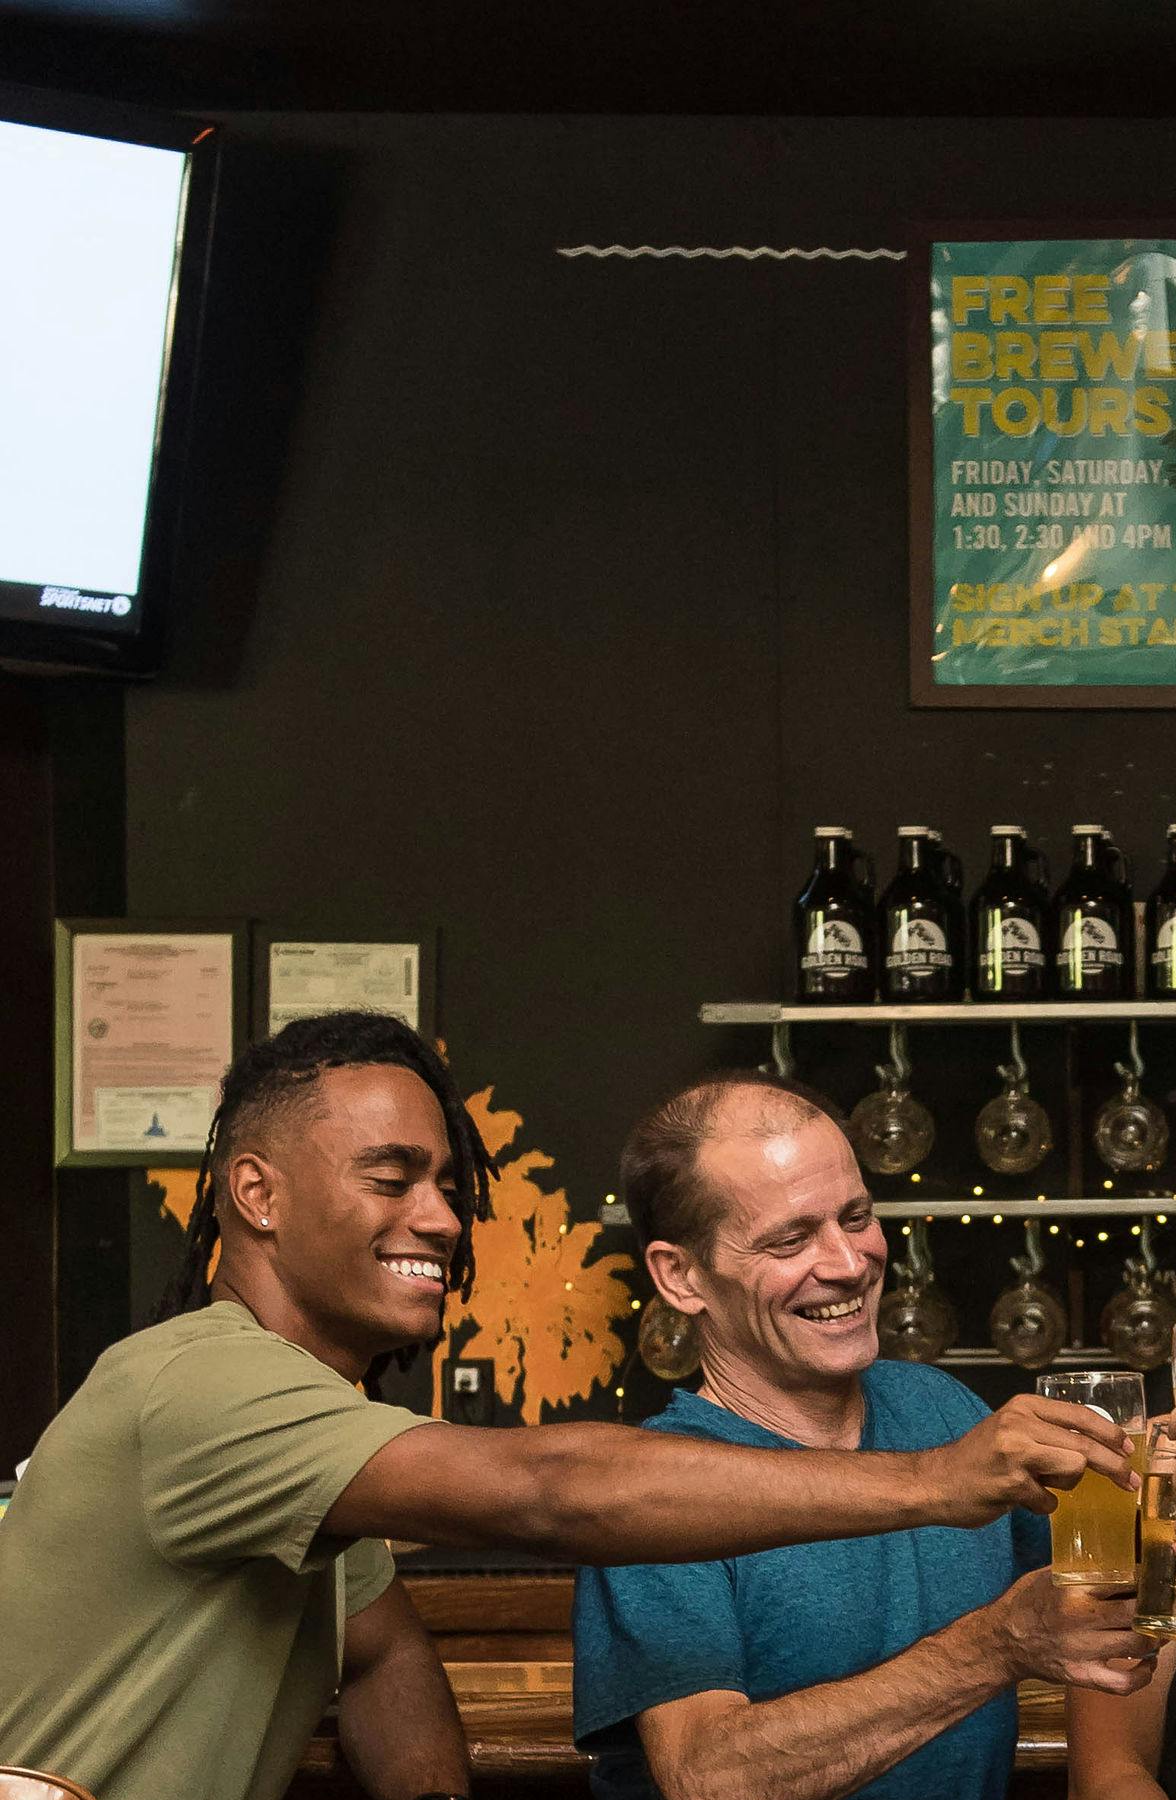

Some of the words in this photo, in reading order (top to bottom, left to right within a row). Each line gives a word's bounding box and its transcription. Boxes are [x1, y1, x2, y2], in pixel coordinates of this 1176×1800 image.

[952, 274, 1111, 325] FREE
[951, 387, 1172, 437] TOURS
[951, 460, 1040, 487] FRIDAY,
[1046, 459, 1169, 487] SATURDAY,
[950, 492, 997, 517] AND
[1003, 492, 1094, 517] SUNDAY
[1099, 492, 1127, 516] AT
[1123, 524, 1172, 549] 4PM
[953, 583, 1041, 612] SIGN
[1051, 583, 1103, 611] UP
[1112, 583, 1165, 611] AT
[952, 617, 1089, 647] MERCH
